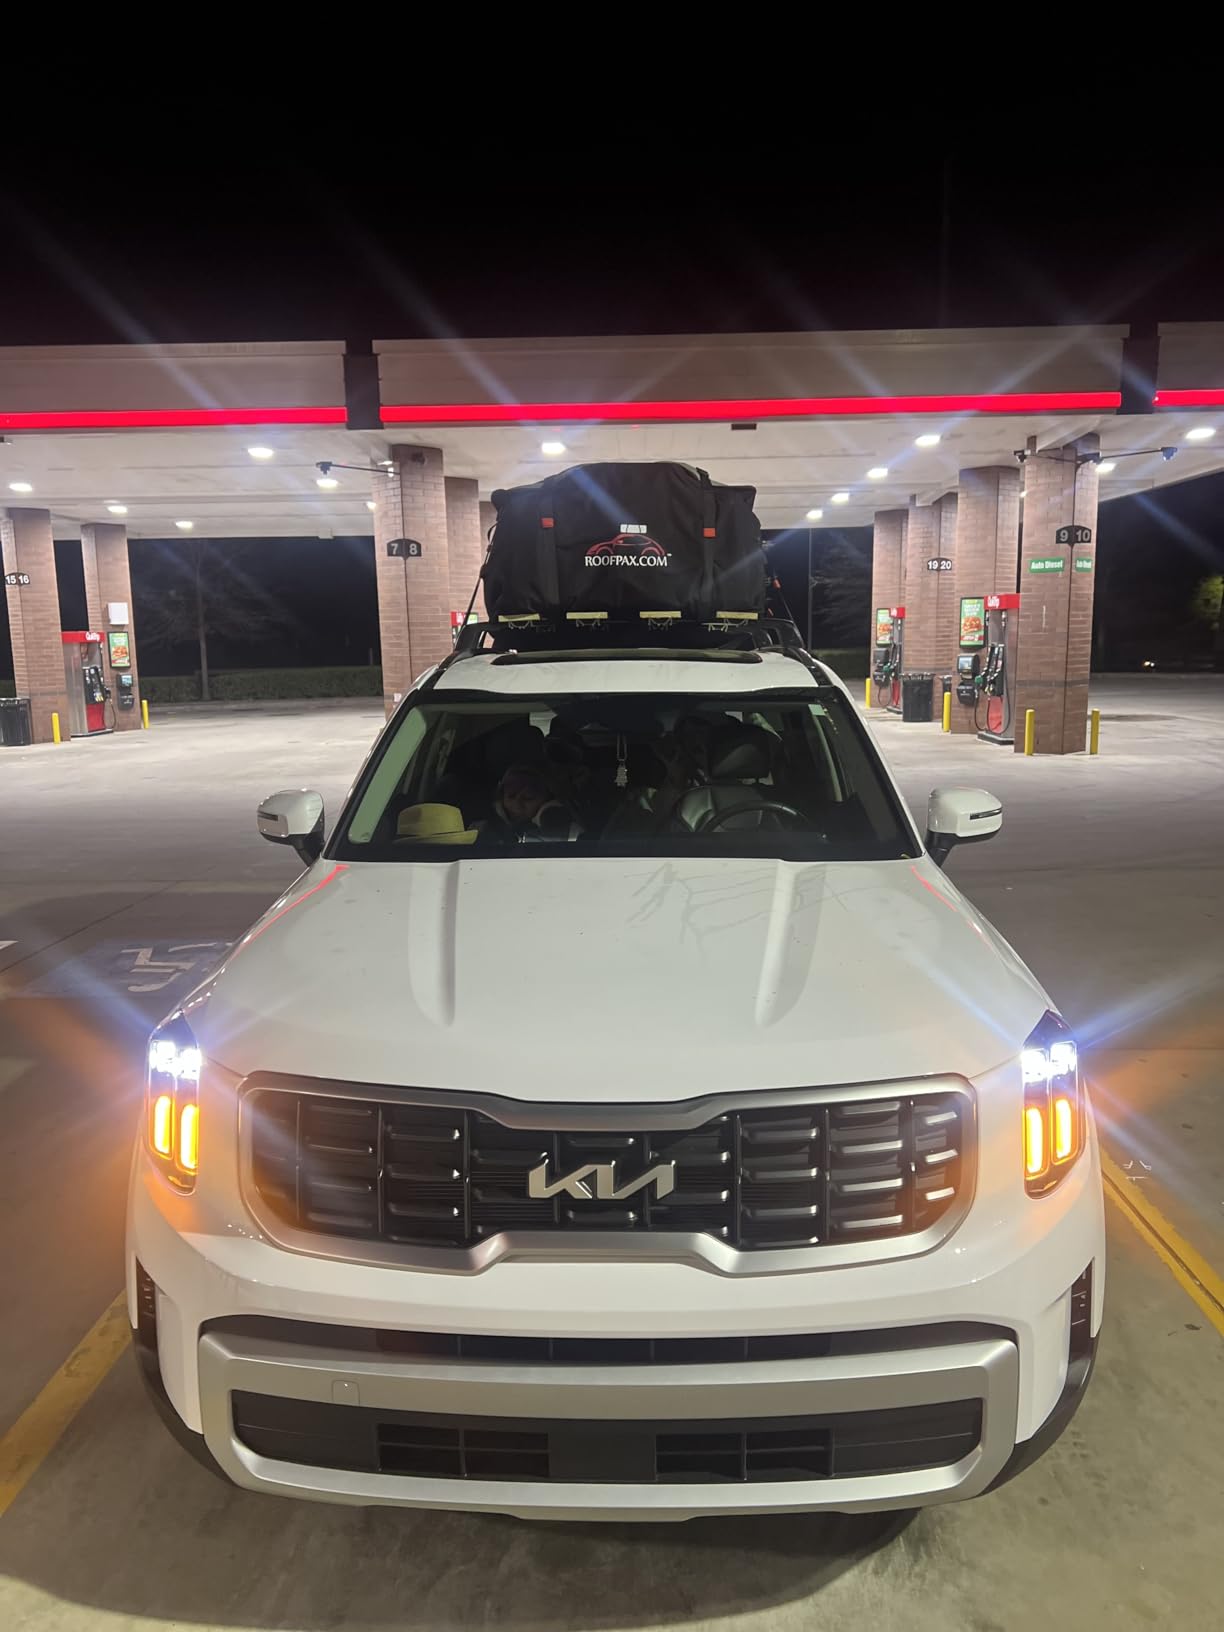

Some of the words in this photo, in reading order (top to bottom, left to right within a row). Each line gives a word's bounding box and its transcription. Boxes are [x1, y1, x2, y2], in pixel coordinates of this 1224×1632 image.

[1060, 530, 1068, 542] 9
[1076, 530, 1090, 542] 10
[391, 543, 399, 555] 7
[409, 543, 417, 555] 8
[585, 555, 667, 567] ROOFPAX.COM
[928, 560, 938, 569] 19
[940, 560, 951, 569] 20
[5, 575, 16, 584] 15
[18, 575, 29, 584] 16
[529, 1158, 675, 1200] KIA
